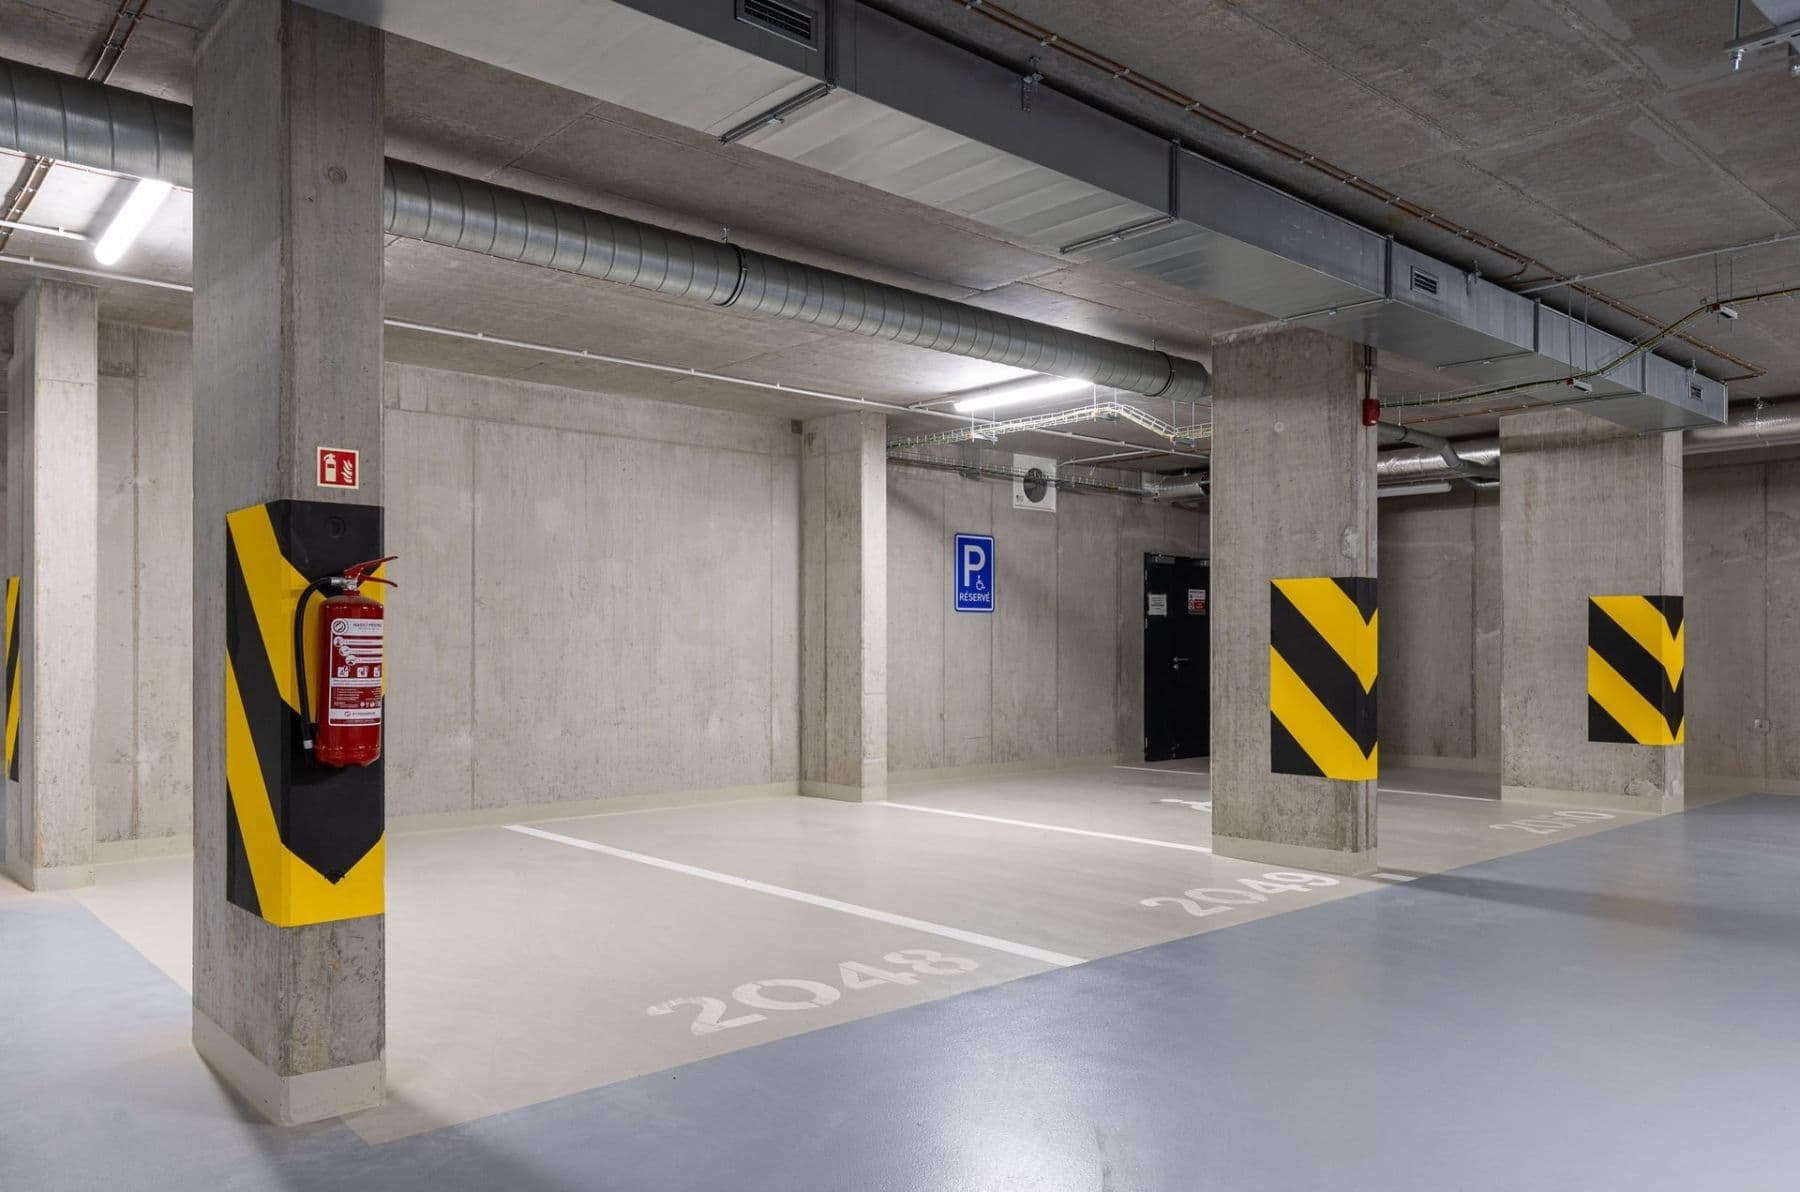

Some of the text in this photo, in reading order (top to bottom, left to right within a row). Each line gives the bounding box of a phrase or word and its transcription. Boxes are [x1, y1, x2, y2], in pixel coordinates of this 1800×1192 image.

[964, 544, 986, 587] P
[1140, 871, 1340, 917] 2049
[647, 948, 980, 1036] 2048
